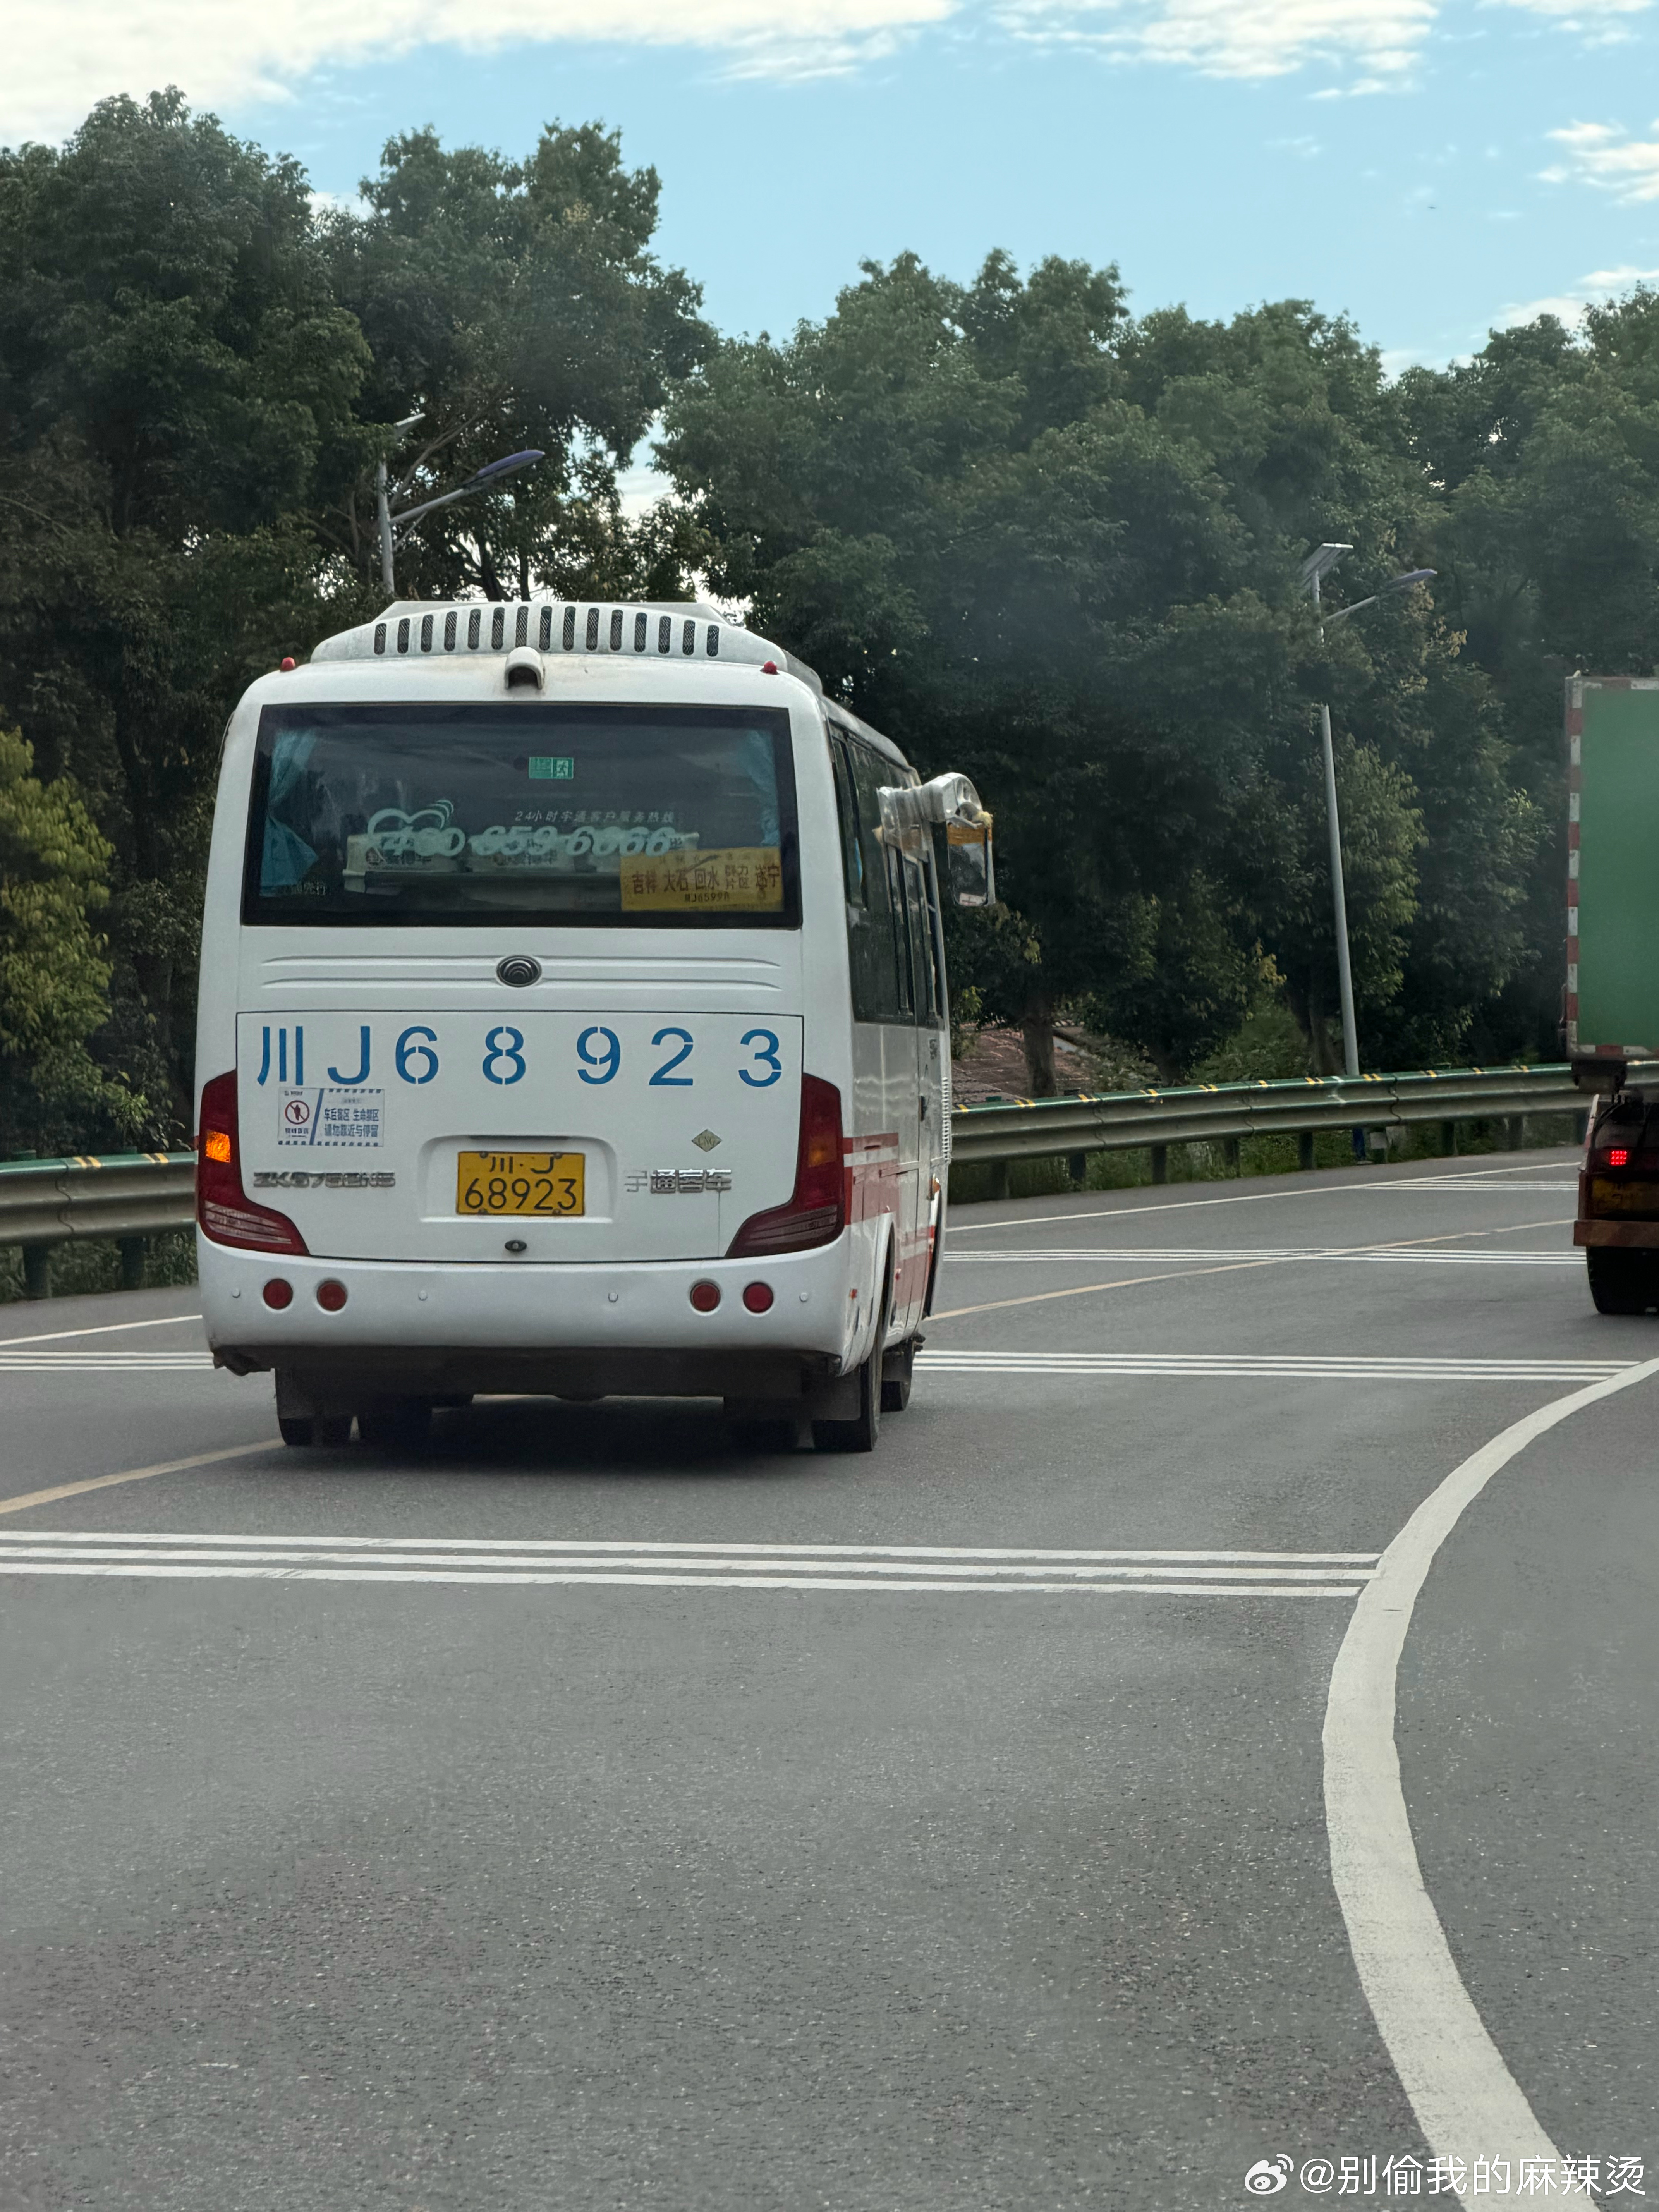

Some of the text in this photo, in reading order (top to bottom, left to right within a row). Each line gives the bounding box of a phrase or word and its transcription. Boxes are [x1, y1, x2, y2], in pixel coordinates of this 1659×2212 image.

[257, 1026, 782, 1087] 川J68923
[465, 1178, 577, 1210] 68923
[623, 1168, 732, 1194] 宇通客车
